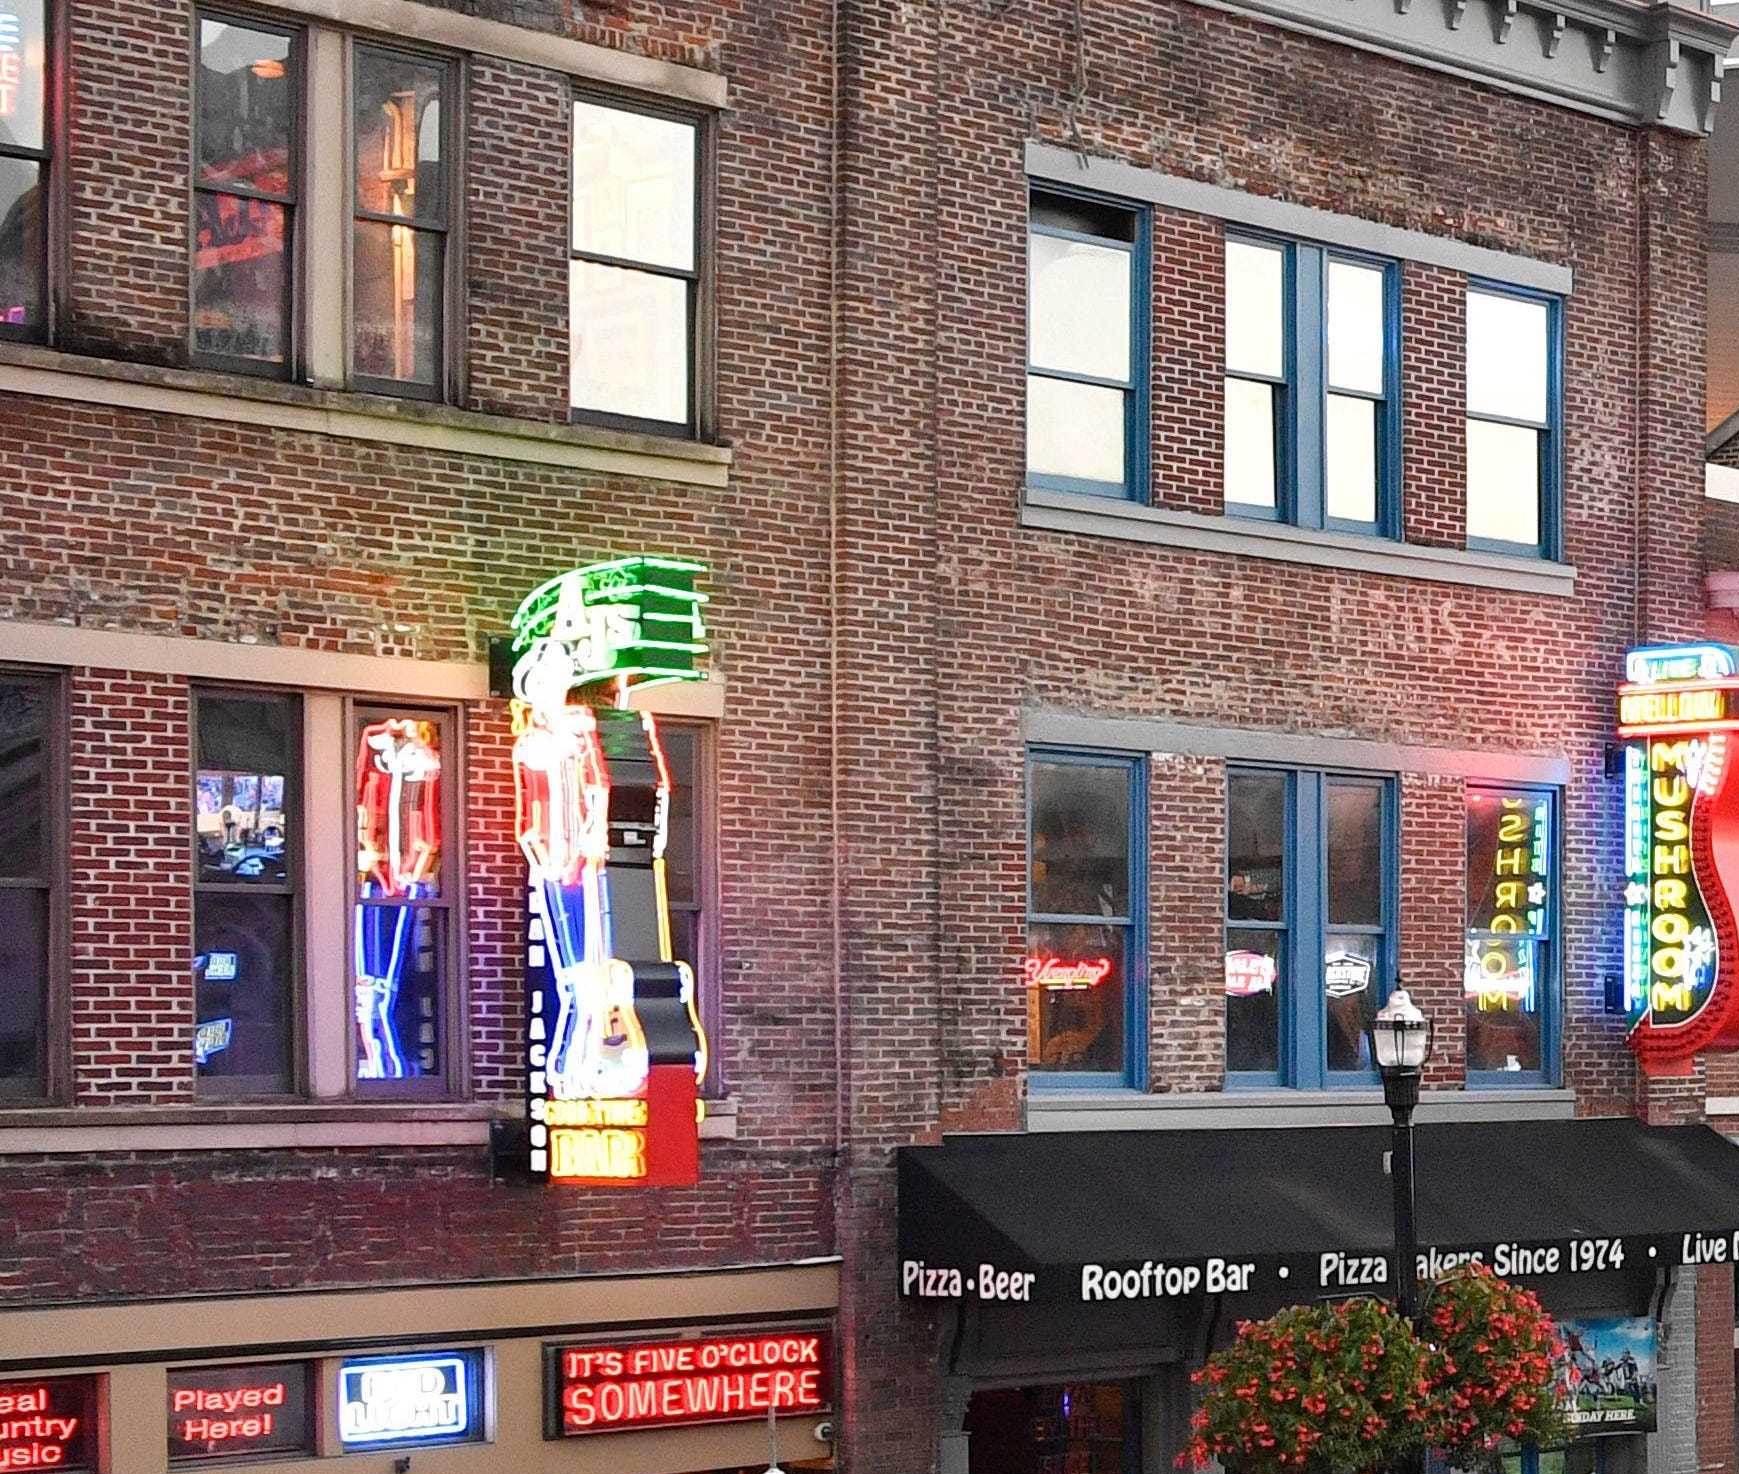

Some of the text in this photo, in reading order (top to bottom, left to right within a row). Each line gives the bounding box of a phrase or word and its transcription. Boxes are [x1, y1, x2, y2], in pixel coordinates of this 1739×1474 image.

[1651, 742, 1690, 1012] MUSHROOM
[528, 990, 548, 1172] JACKSON
[551, 1129, 647, 1179] BAR
[903, 1260, 1036, 1301] Pizza Beer
[1081, 1261, 1201, 1301] Rooftop
[1206, 1257, 1256, 1294] Bar
[1319, 1251, 1388, 1288] Pizza
[1415, 1246, 1484, 1281] akers
[1494, 1242, 1560, 1278] Since
[1569, 1238, 1625, 1273] 1974
[1682, 1231, 1728, 1264] Live
[569, 1338, 819, 1379] IT'S FIVE O'CLOCK
[0, 1389, 47, 1412] eal
[173, 1383, 285, 1413] Played
[570, 1370, 821, 1426] SOMEWHERE
[0, 1417, 78, 1441] untry
[184, 1414, 273, 1441] Here!
[0, 1443, 62, 1466] usic
